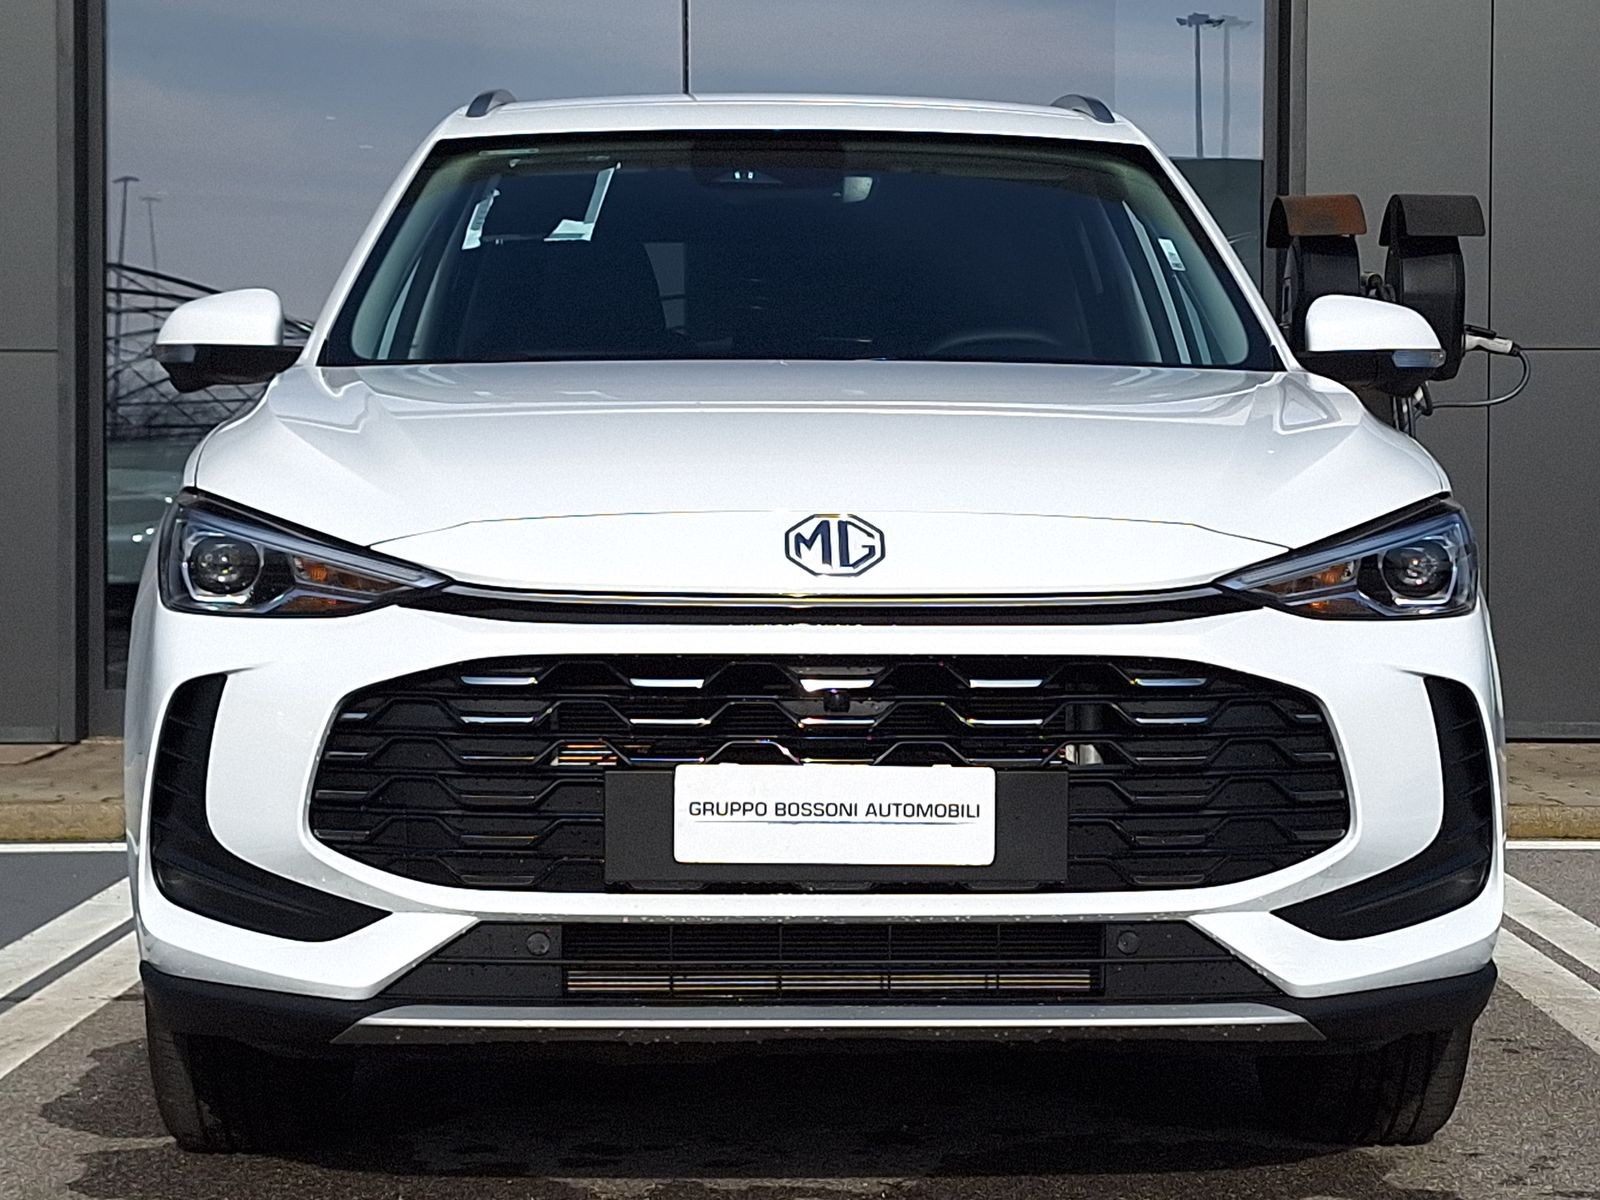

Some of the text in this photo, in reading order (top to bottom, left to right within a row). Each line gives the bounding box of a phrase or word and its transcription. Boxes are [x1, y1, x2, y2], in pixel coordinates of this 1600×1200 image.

[794, 519, 876, 569] MG
[688, 800, 980, 819] GRUPPO BOSSONI AUTOMOBILI
